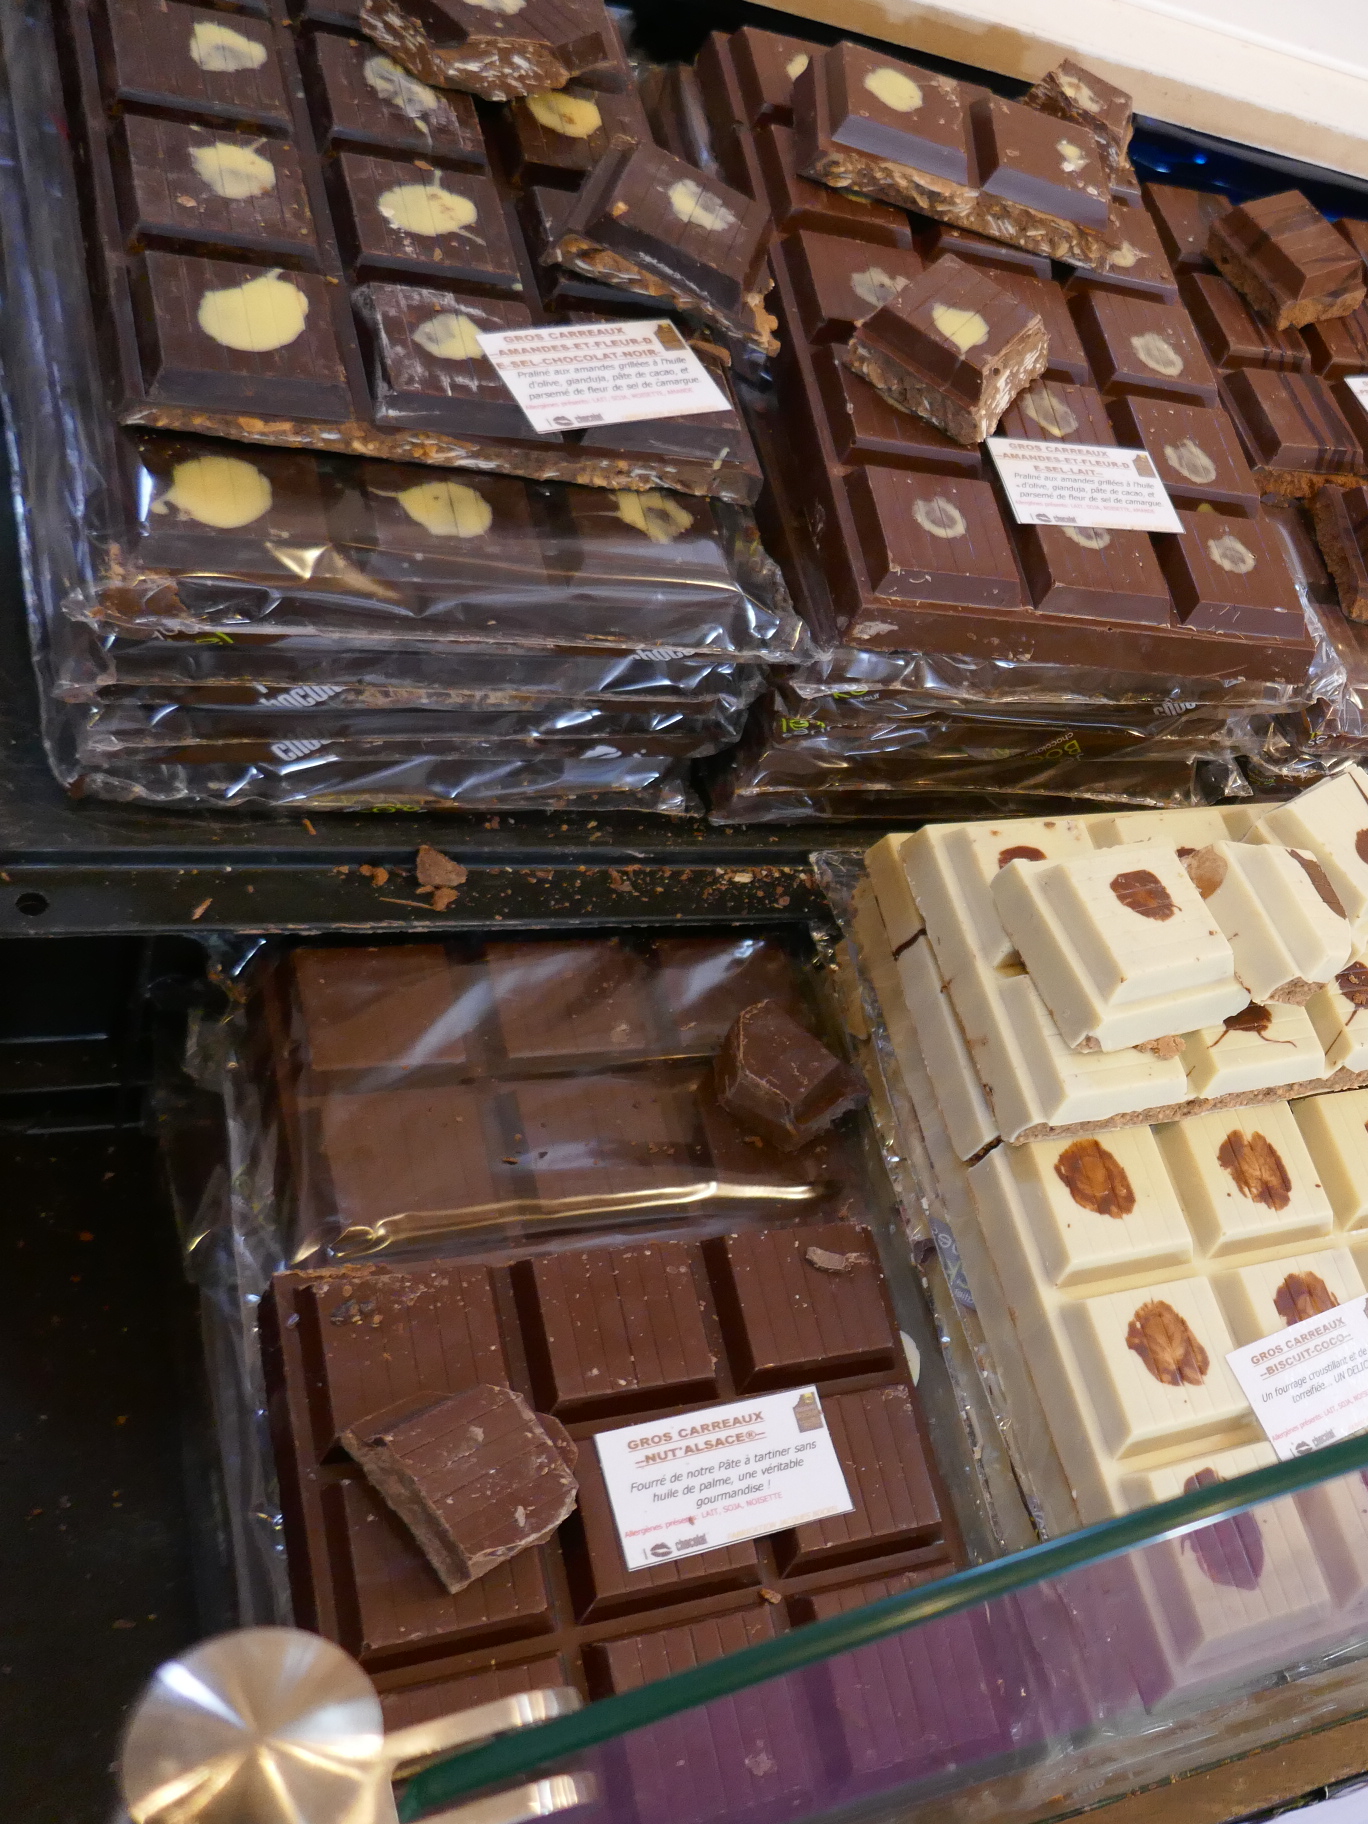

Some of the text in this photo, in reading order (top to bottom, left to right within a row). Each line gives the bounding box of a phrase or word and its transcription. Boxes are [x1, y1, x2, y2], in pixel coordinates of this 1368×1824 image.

[503, 327, 625, 343] GROS CARREAUX
[516, 369, 551, 379] Praliné
[573, 363, 616, 374] amandes
[611, 372, 633, 382] pâte
[634, 371, 647, 379] de
[528, 389, 571, 401] parsemé
[572, 388, 586, 396] de
[587, 386, 609, 394] fleur
[611, 384, 624, 392] de
[625, 382, 640, 390] sel
[640, 381, 654, 389] de
[1009, 443, 1108, 457] GROS CARREAUX
[1014, 472, 1042, 480] Praliné
[1060, 477, 1096, 485] amandes
[1019, 491, 1054, 500] parsemé
[1068, 494, 1087, 502] fleur
[1090, 487, 1108, 495] pâte
[1250, 1317, 1345, 1365] GROS CARREAUX
[1261, 1391, 1274, 1403] Un
[1274, 1376, 1308, 1397] fourrage
[1308, 1356, 1348, 1381] croustillant
[1348, 1352, 1358, 1362] et
[1357, 1347, 1368, 1358] de
[1333, 1371, 1347, 1384] UN
[627, 1412, 764, 1450] GROS CARREAUX
[630, 1441, 817, 1493] Fourré de notre Pâte à tartiner sans
[652, 1457, 804, 1503] huile de palme, une véritable
[695, 1483, 765, 1510] gourmandise
